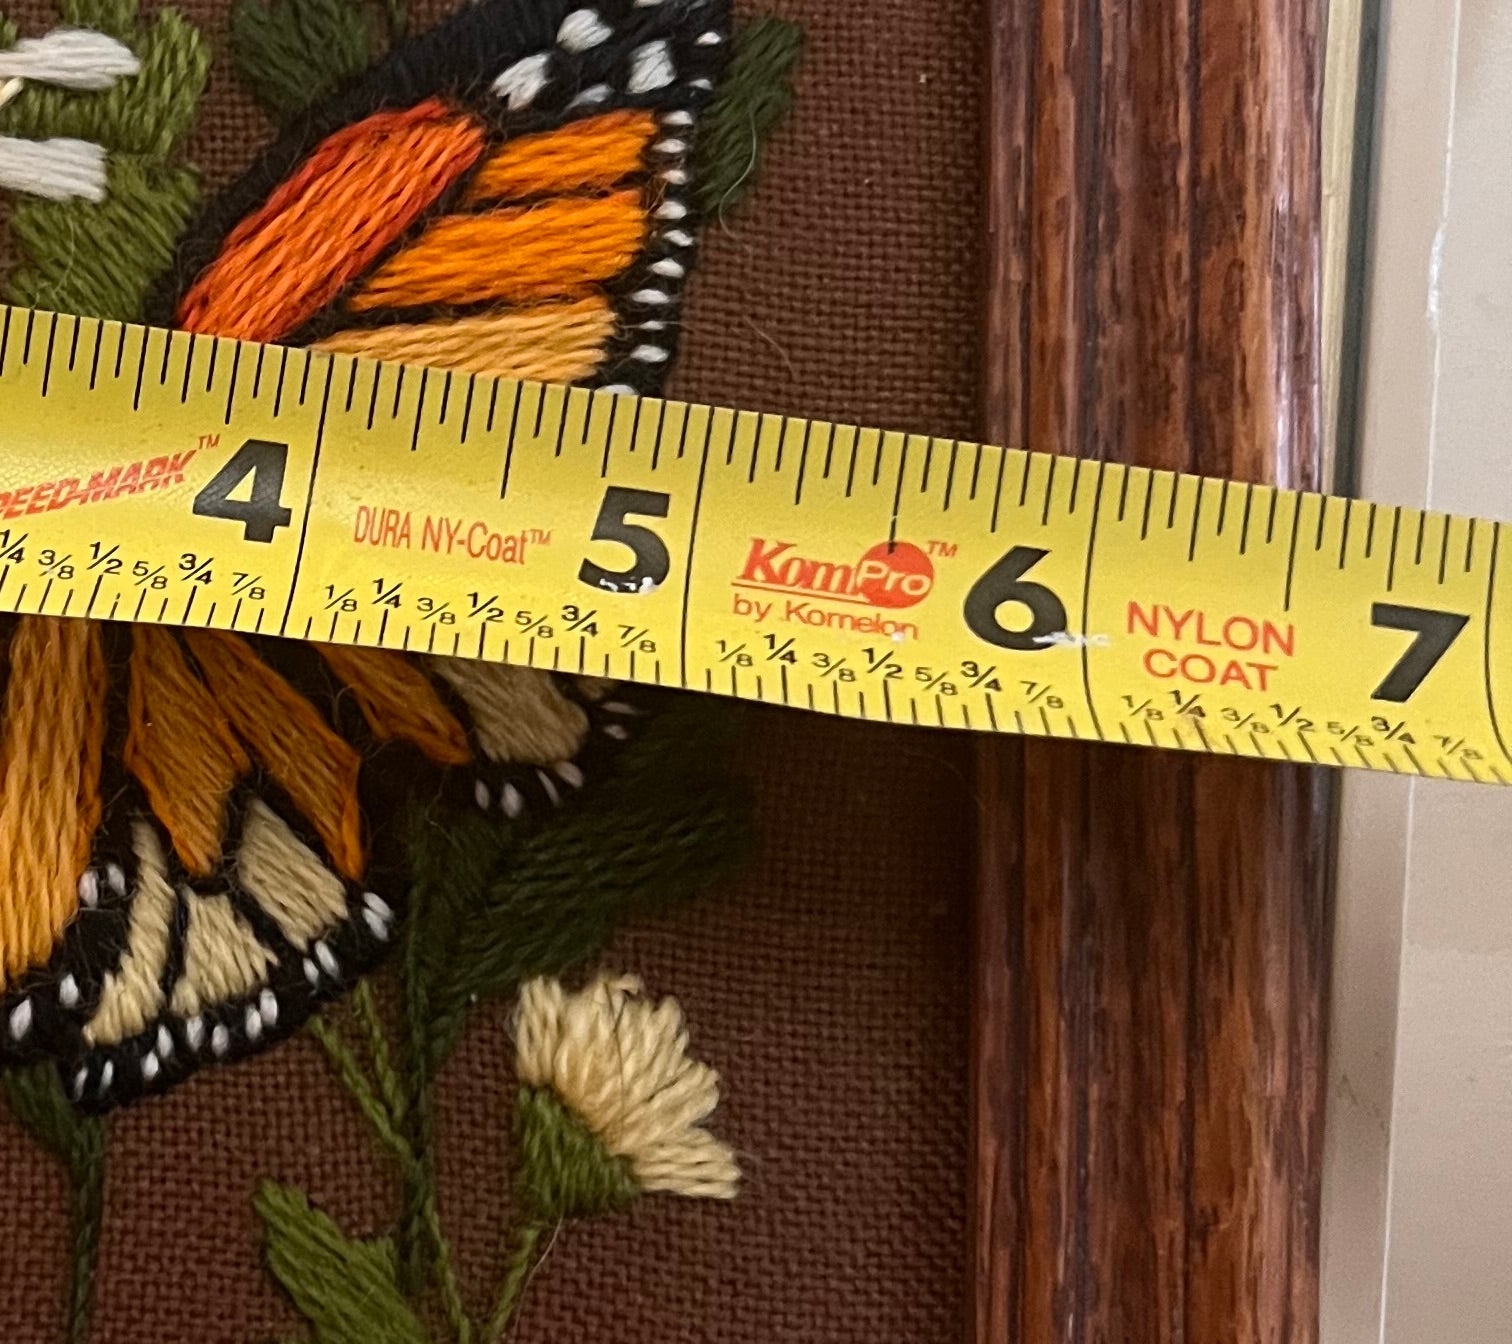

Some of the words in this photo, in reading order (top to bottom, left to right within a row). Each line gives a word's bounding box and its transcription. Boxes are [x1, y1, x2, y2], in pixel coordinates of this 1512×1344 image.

[193, 439, 292, 544] 4
[354, 505, 412, 550] DURA
[577, 486, 671, 594] 5
[38, 550, 74, 580] 3/8
[88, 541, 122, 575] 1/2
[133, 560, 168, 590] 5/8
[178, 553, 213, 586] 3/4
[230, 572, 265, 600] 7/8
[326, 584, 358, 612] 1/8
[367, 578, 403, 609] 1/4
[417, 597, 456, 625] 3/8
[466, 592, 504, 622] 1/2
[515, 609, 554, 639] 5/8
[560, 604, 598, 636] 3/4
[618, 624, 657, 654] 7/8
[715, 639, 754, 667] 1/8
[762, 633, 798, 664] 1/4
[813, 653, 856, 683] 3/8
[862, 648, 904, 680] 1/2
[914, 667, 959, 697] 5/8
[959, 660, 1003, 693] 3/4
[1019, 681, 1064, 711] 7/8
[1270, 703, 1315, 733] 1/2
[733, 593, 773, 623] by
[963, 545, 1068, 651] 6
[1127, 601, 1295, 656] NYLON
[1142, 650, 1279, 692] COAT
[1370, 603, 1470, 703] 7
